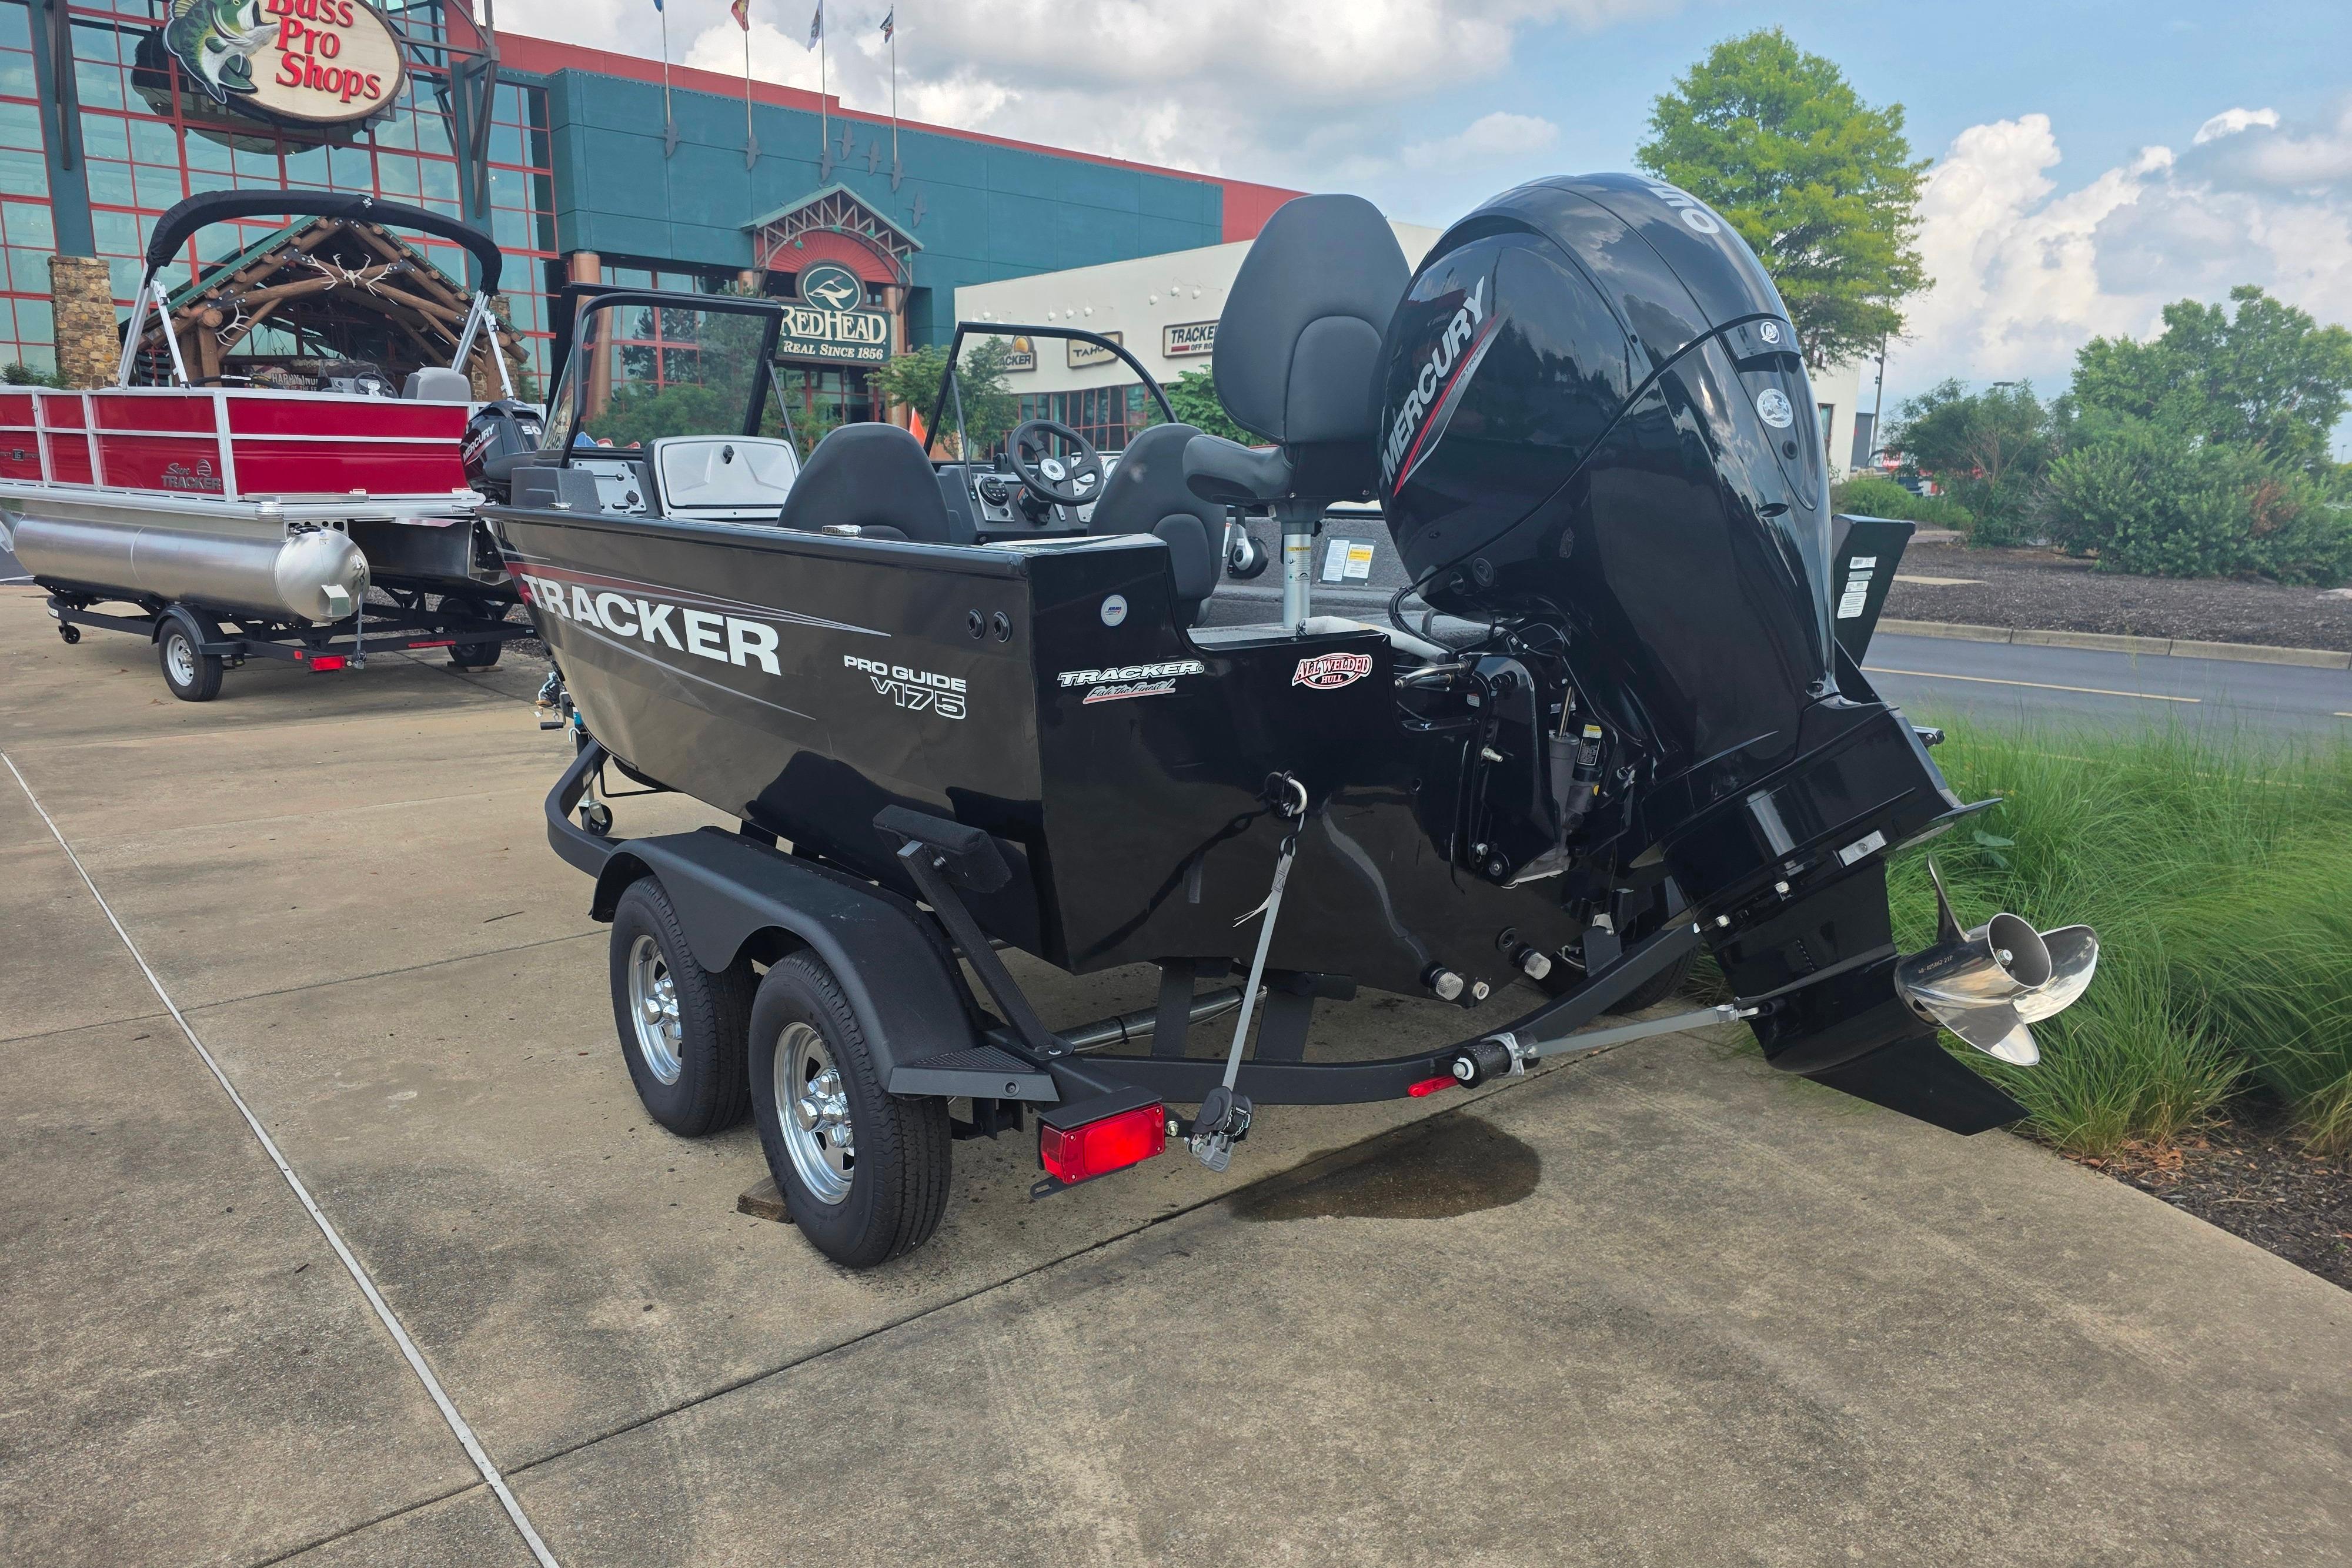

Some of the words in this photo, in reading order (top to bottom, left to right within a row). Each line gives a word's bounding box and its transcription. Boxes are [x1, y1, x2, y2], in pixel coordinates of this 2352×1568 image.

[275, 16, 340, 59] Pro
[276, 51, 381, 103] Shops
[783, 340, 815, 355] REAL
[820, 344, 855, 357] SINCE
[857, 347, 884, 360] 1856
[999, 355, 1031, 366] ACKER
[1382, 276, 1484, 486] MERCURY
[463, 423, 495, 463] MERCURY
[521, 425, 542, 436] 50
[161, 475, 221, 490] TRACKER
[520, 573, 781, 676] TRACKER
[844, 655, 888, 676] PRO
[891, 666, 967, 693] GUIDE
[1058, 661, 1200, 687] TRACKER
[1294, 660, 1320, 681] ALL
[1322, 657, 1371, 674] WELDED
[1321, 674, 1343, 684] HULL
[870, 676, 966, 720] V175
[1089, 687, 1114, 697] Fish
[1112, 686, 1130, 694] the
